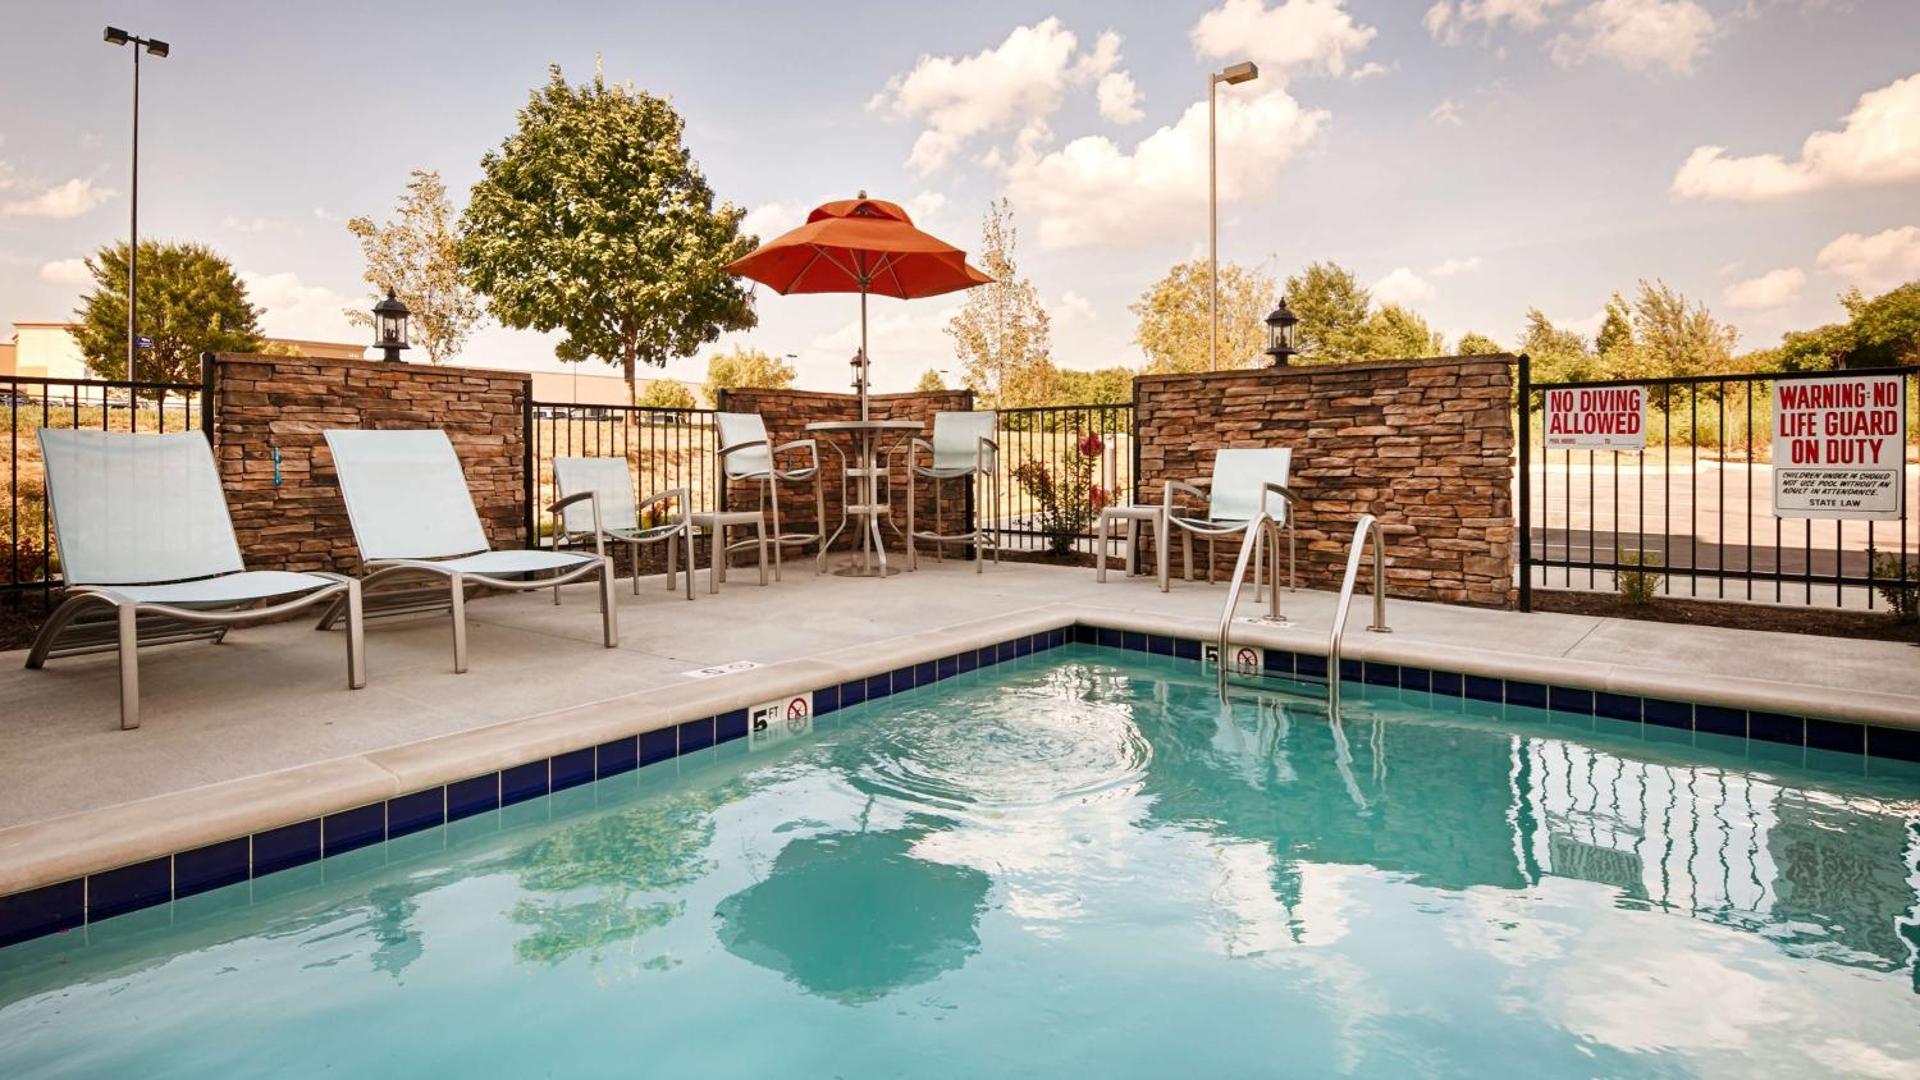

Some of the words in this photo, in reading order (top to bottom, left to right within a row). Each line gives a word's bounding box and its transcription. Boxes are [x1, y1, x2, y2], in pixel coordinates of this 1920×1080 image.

[1551, 390, 1574, 412] NO
[1580, 389, 1640, 412] DIVING
[1780, 382, 1870, 410] WARNING:
[1873, 382, 1898, 408] NO
[1550, 412, 1640, 434] ALLOWED
[1780, 412, 1817, 437] LIFE
[1825, 410, 1898, 436] GUARD
[1791, 439, 1819, 464] ON
[1826, 439, 1883, 464] DUTY
[1822, 472, 1849, 480] UNDER
[1840, 499, 1861, 507] LAW
[1206, 645, 1219, 662] 5
[753, 708, 768, 732] 5
[769, 706, 779, 719] FT
